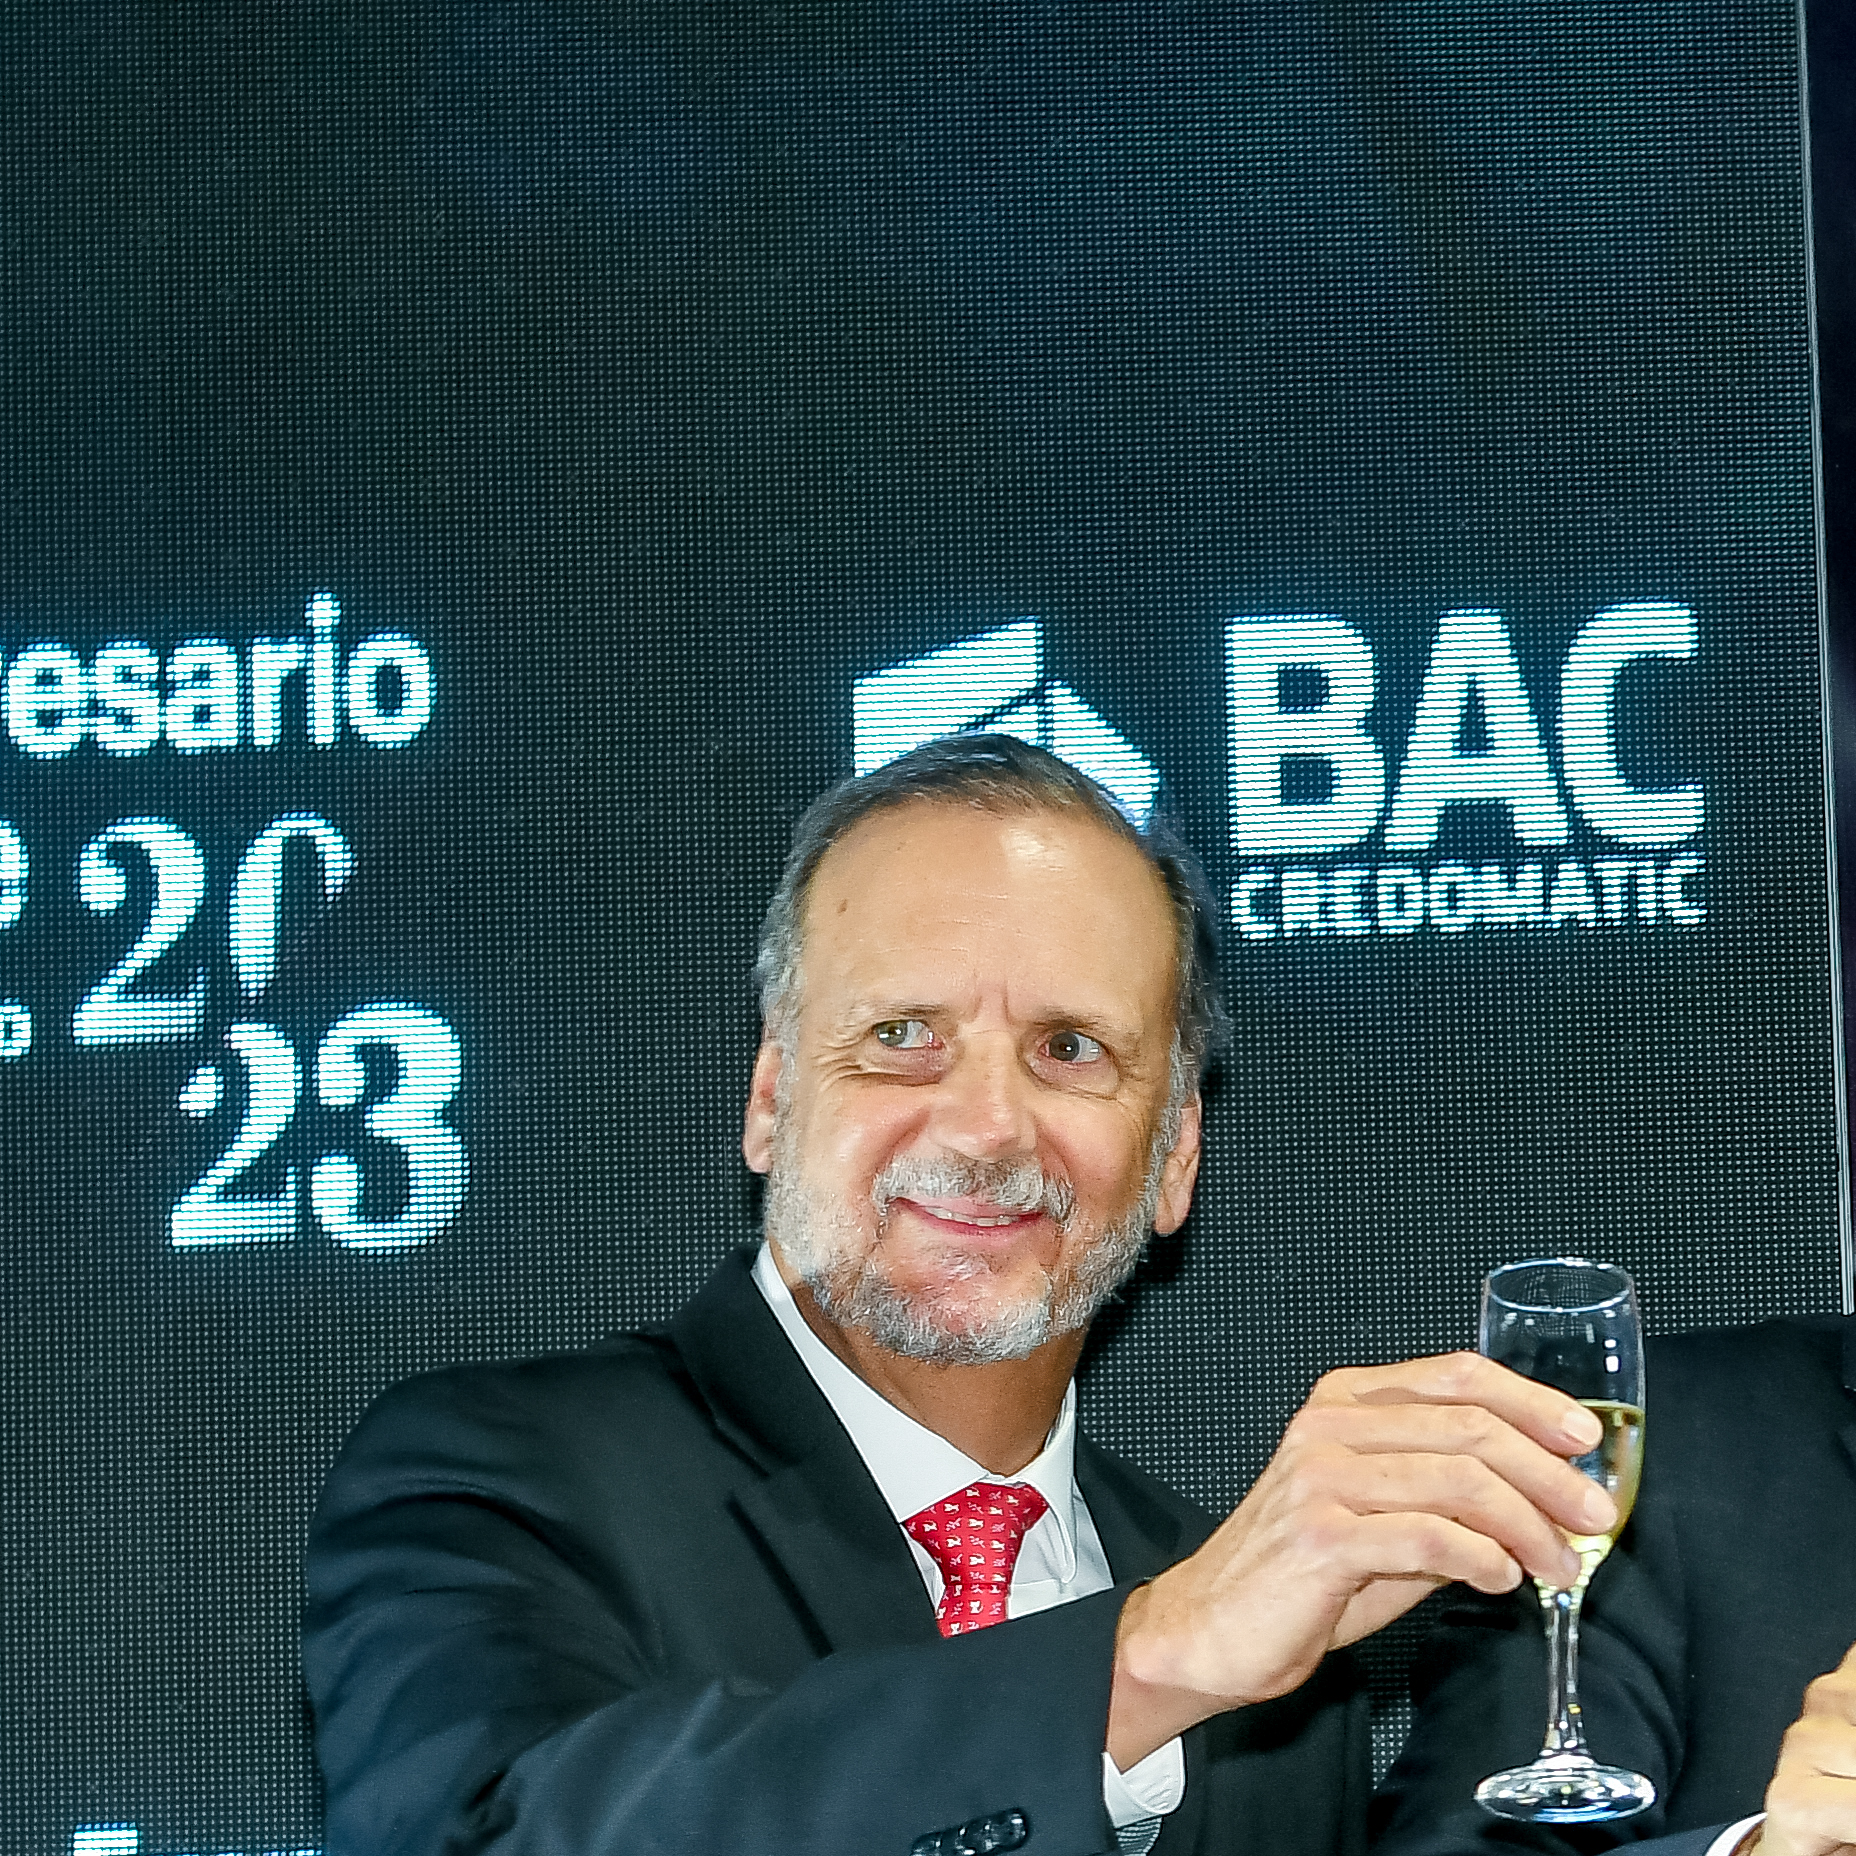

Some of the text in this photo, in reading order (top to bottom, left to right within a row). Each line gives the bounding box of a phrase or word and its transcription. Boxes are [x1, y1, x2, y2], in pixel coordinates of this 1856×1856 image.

[0, 591, 435, 758] esario
[1224, 601, 1706, 857] BAC
[1230, 852, 1707, 940] CREDOMATIC
[168, 1001, 470, 1256] 23
